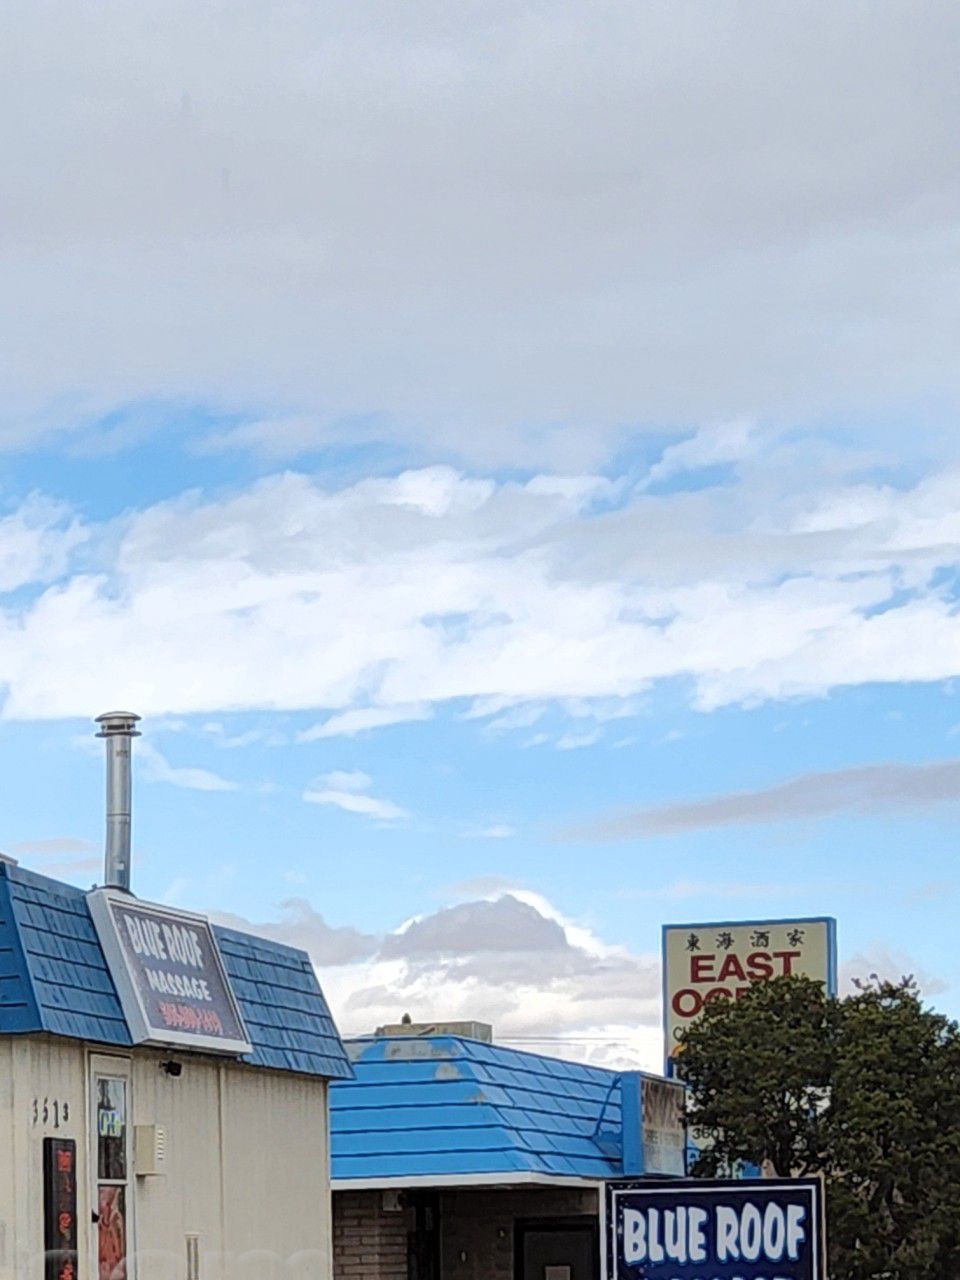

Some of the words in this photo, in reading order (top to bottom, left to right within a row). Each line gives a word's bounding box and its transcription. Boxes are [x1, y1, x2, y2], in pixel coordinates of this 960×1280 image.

[123, 914, 167, 960] BLUE
[161, 924, 204, 968] ROOF
[685, 928, 805, 952] 東海酒家
[690, 951, 801, 983] EAST
[144, 968, 213, 1002] MASSAGE
[622, 1205, 708, 1264] BLUE
[715, 1201, 806, 1262] ROOF
